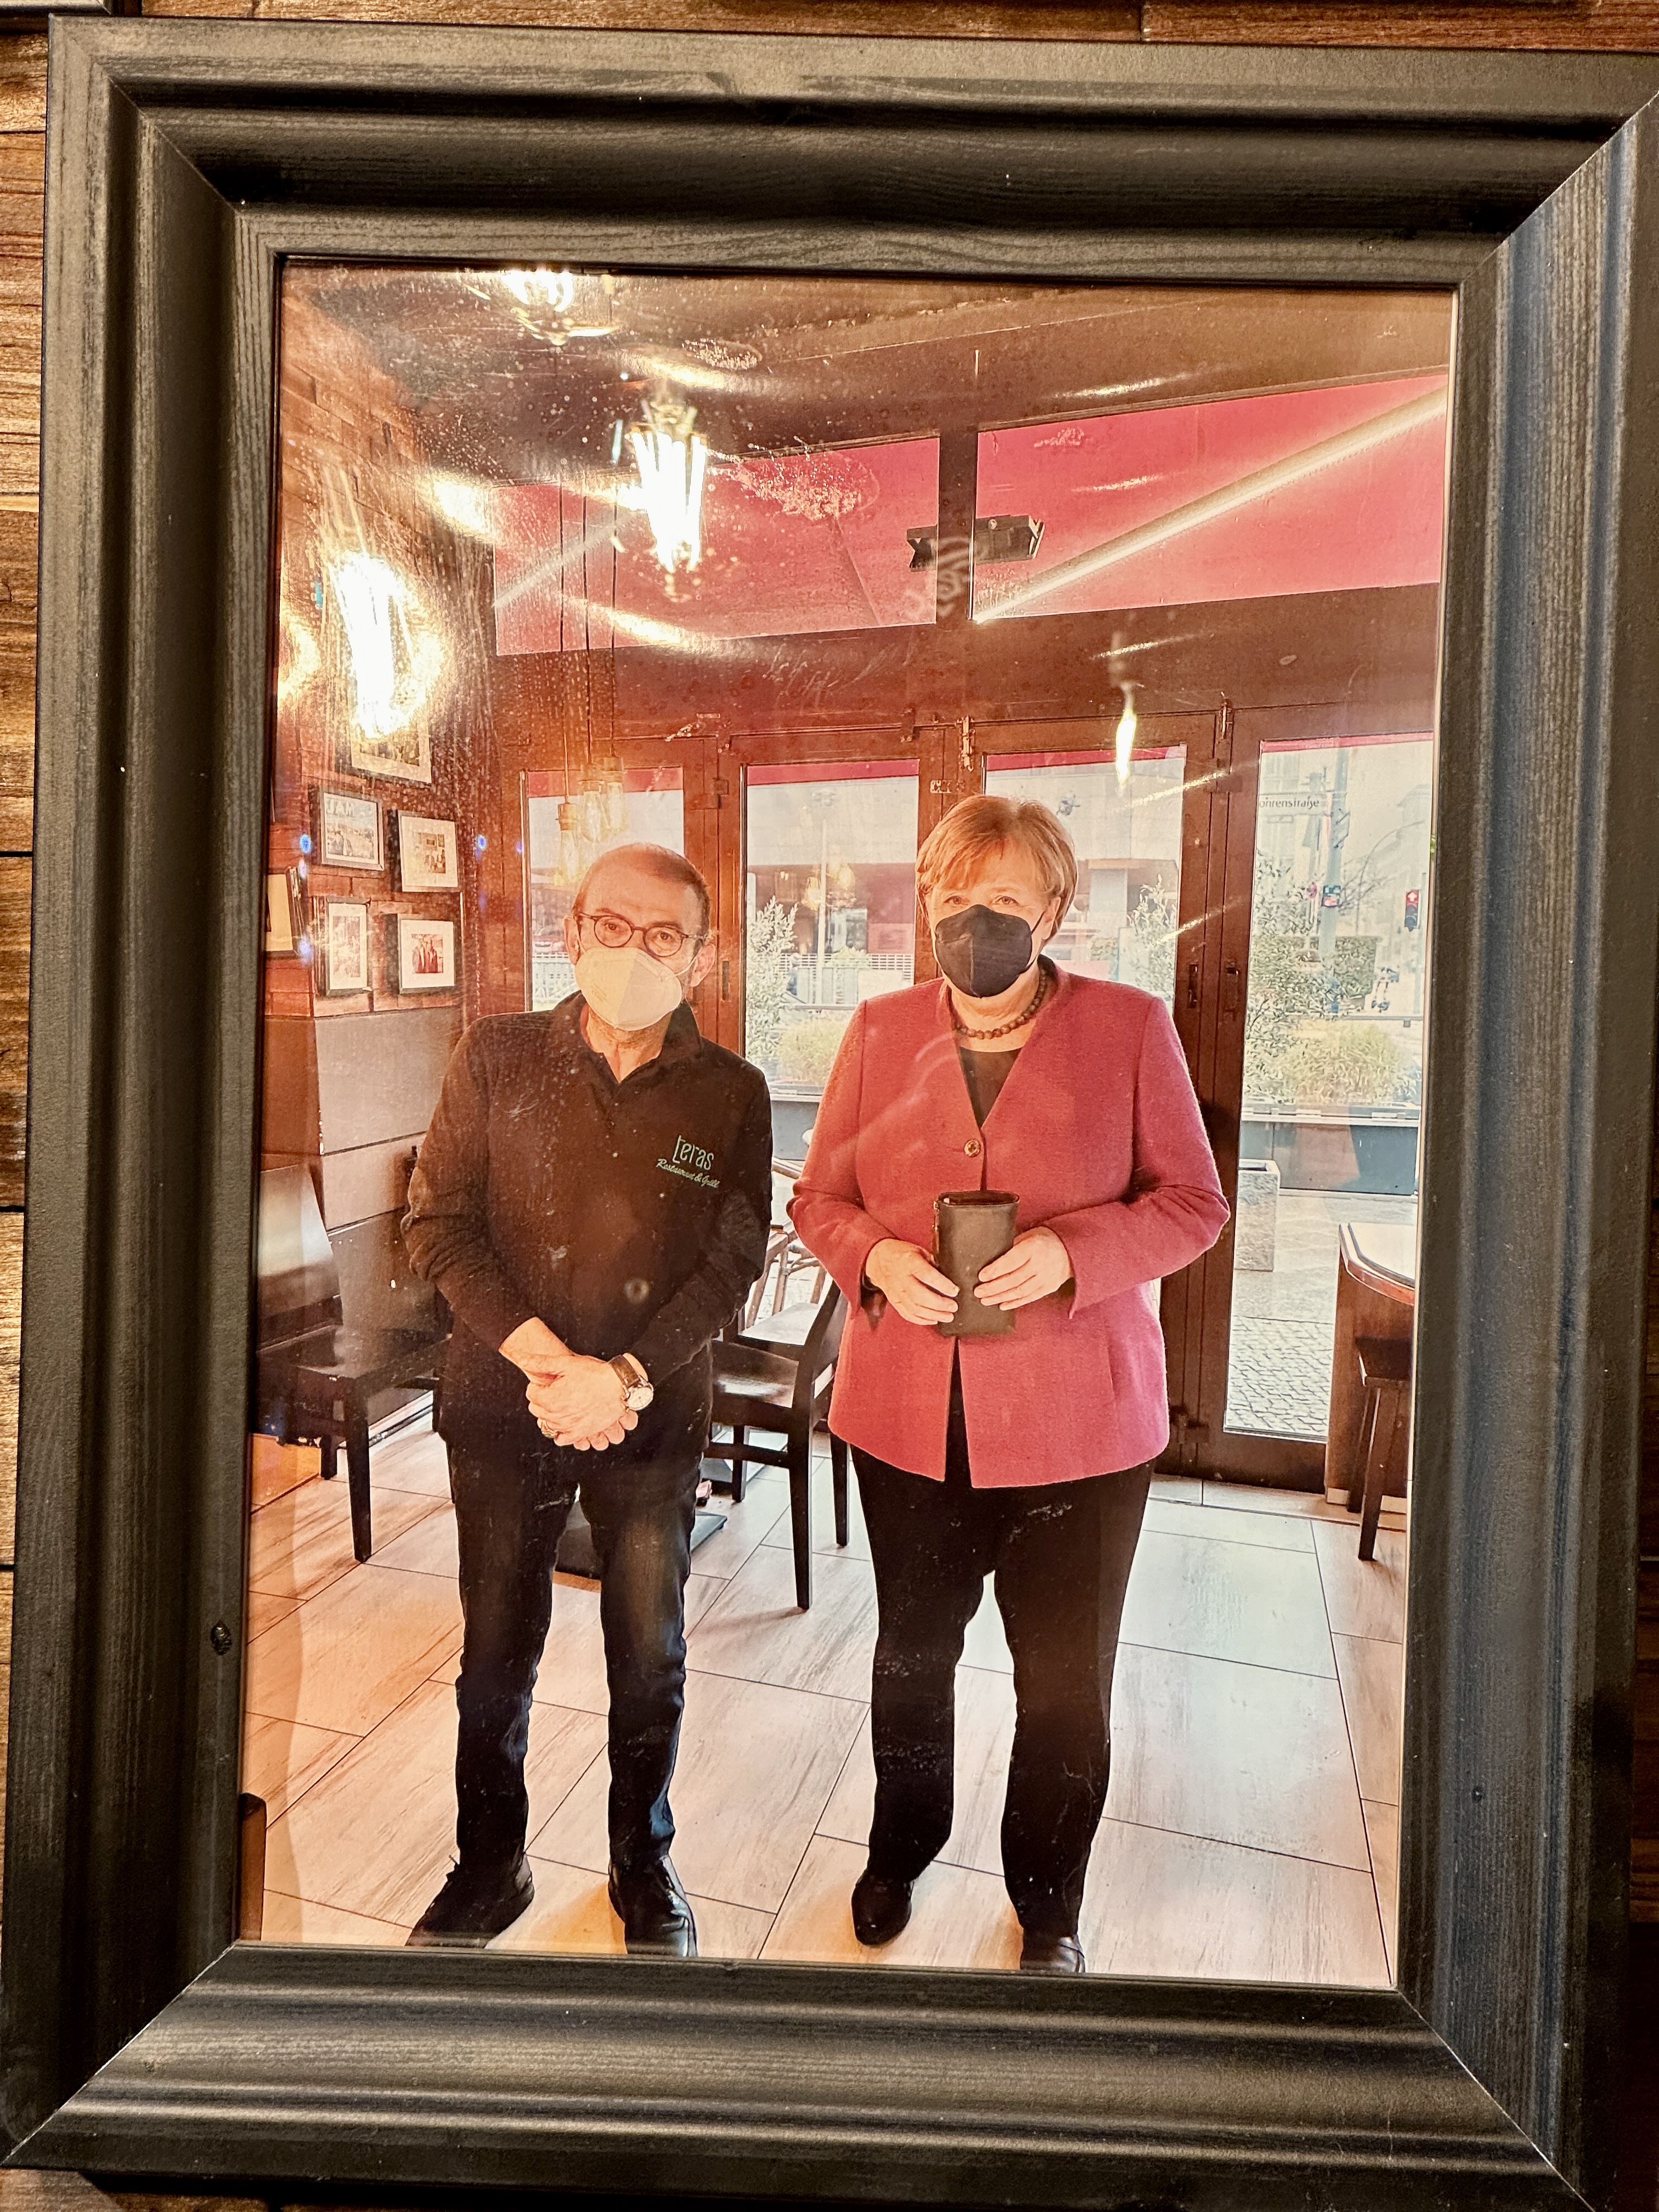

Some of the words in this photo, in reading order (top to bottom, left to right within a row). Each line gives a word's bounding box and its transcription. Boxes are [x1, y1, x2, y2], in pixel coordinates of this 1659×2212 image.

[1260, 795, 1319, 809] ohrenstraße
[656, 1158, 696, 1180] Restaurant
[694, 1173, 703, 1182] &
[701, 1175, 720, 1188] Grill
